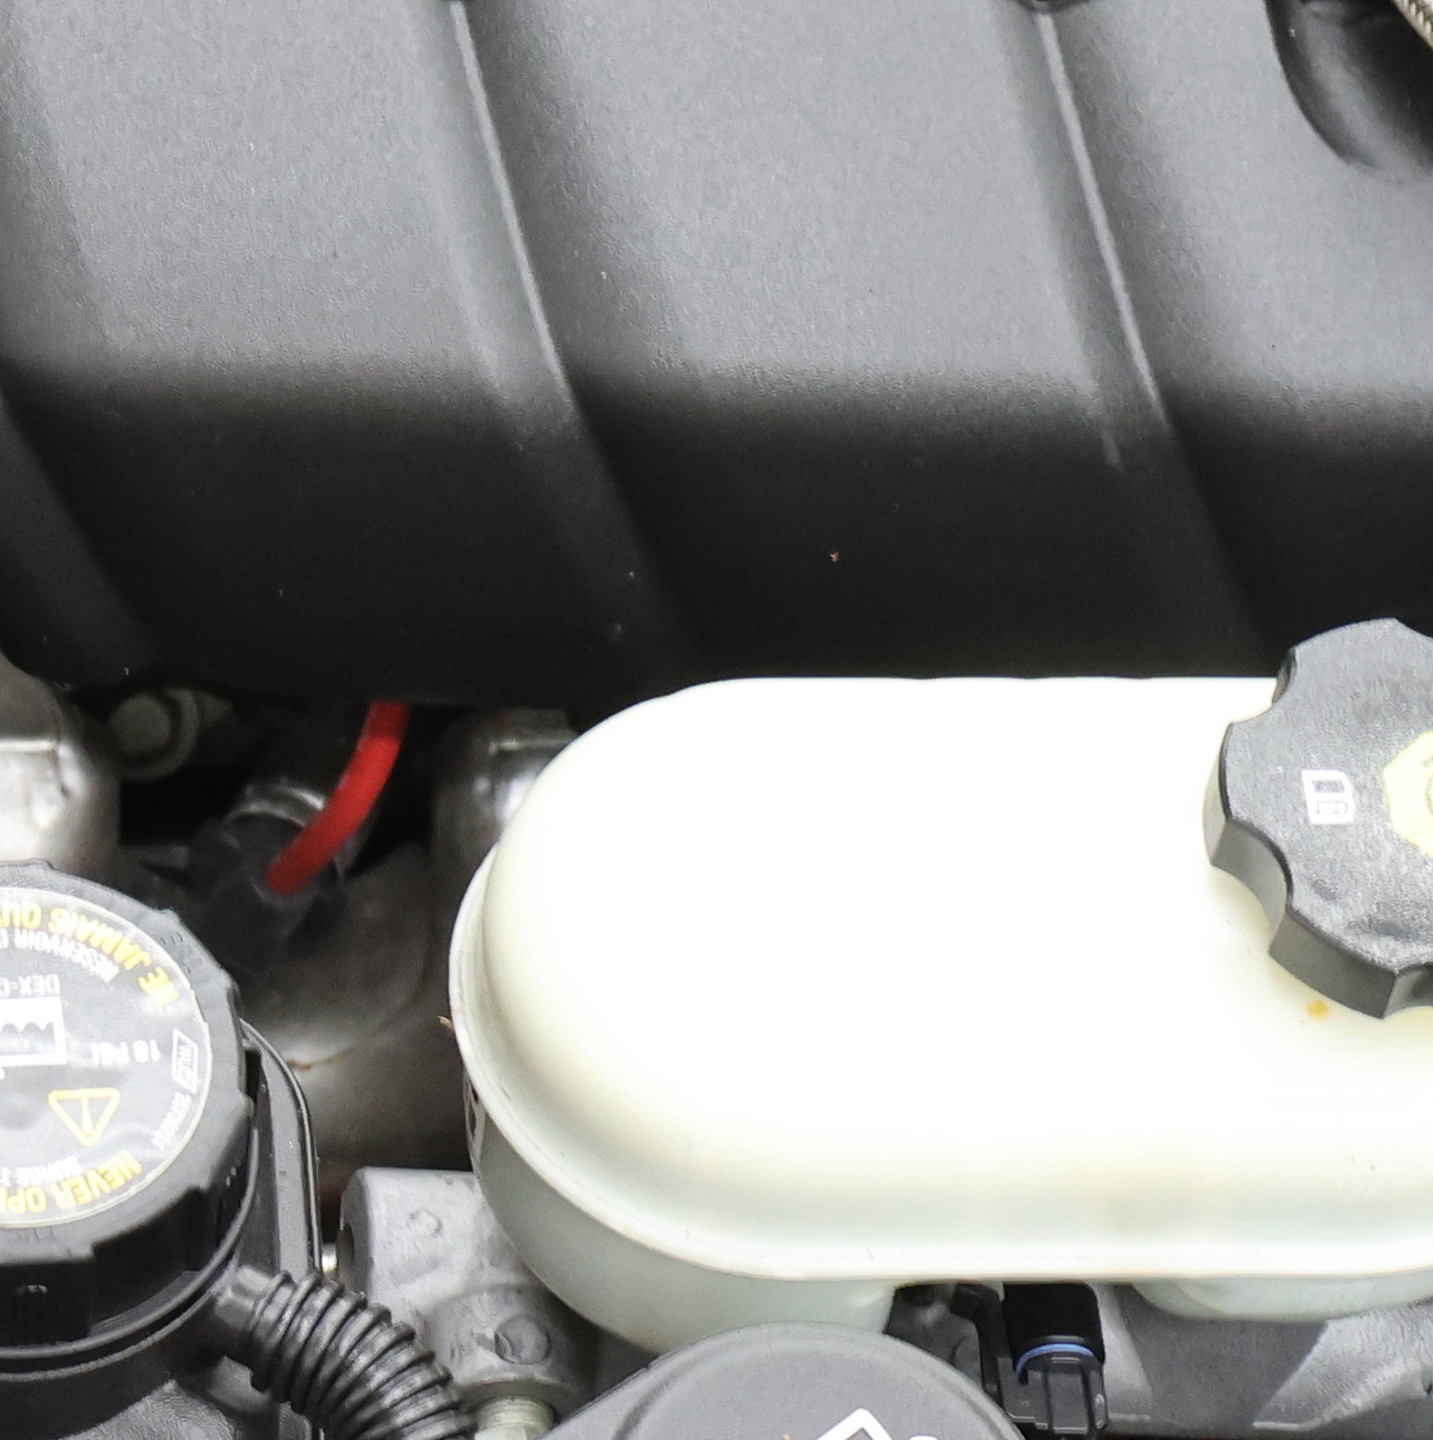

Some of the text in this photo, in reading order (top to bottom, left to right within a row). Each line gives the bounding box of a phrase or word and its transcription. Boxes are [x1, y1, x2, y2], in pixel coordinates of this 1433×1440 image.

[47, 907, 153, 971] JAMAIS
[137, 966, 180, 1008] NE
[90, 1040, 130, 1069] PSI
[51, 1149, 143, 1211] NEVER
